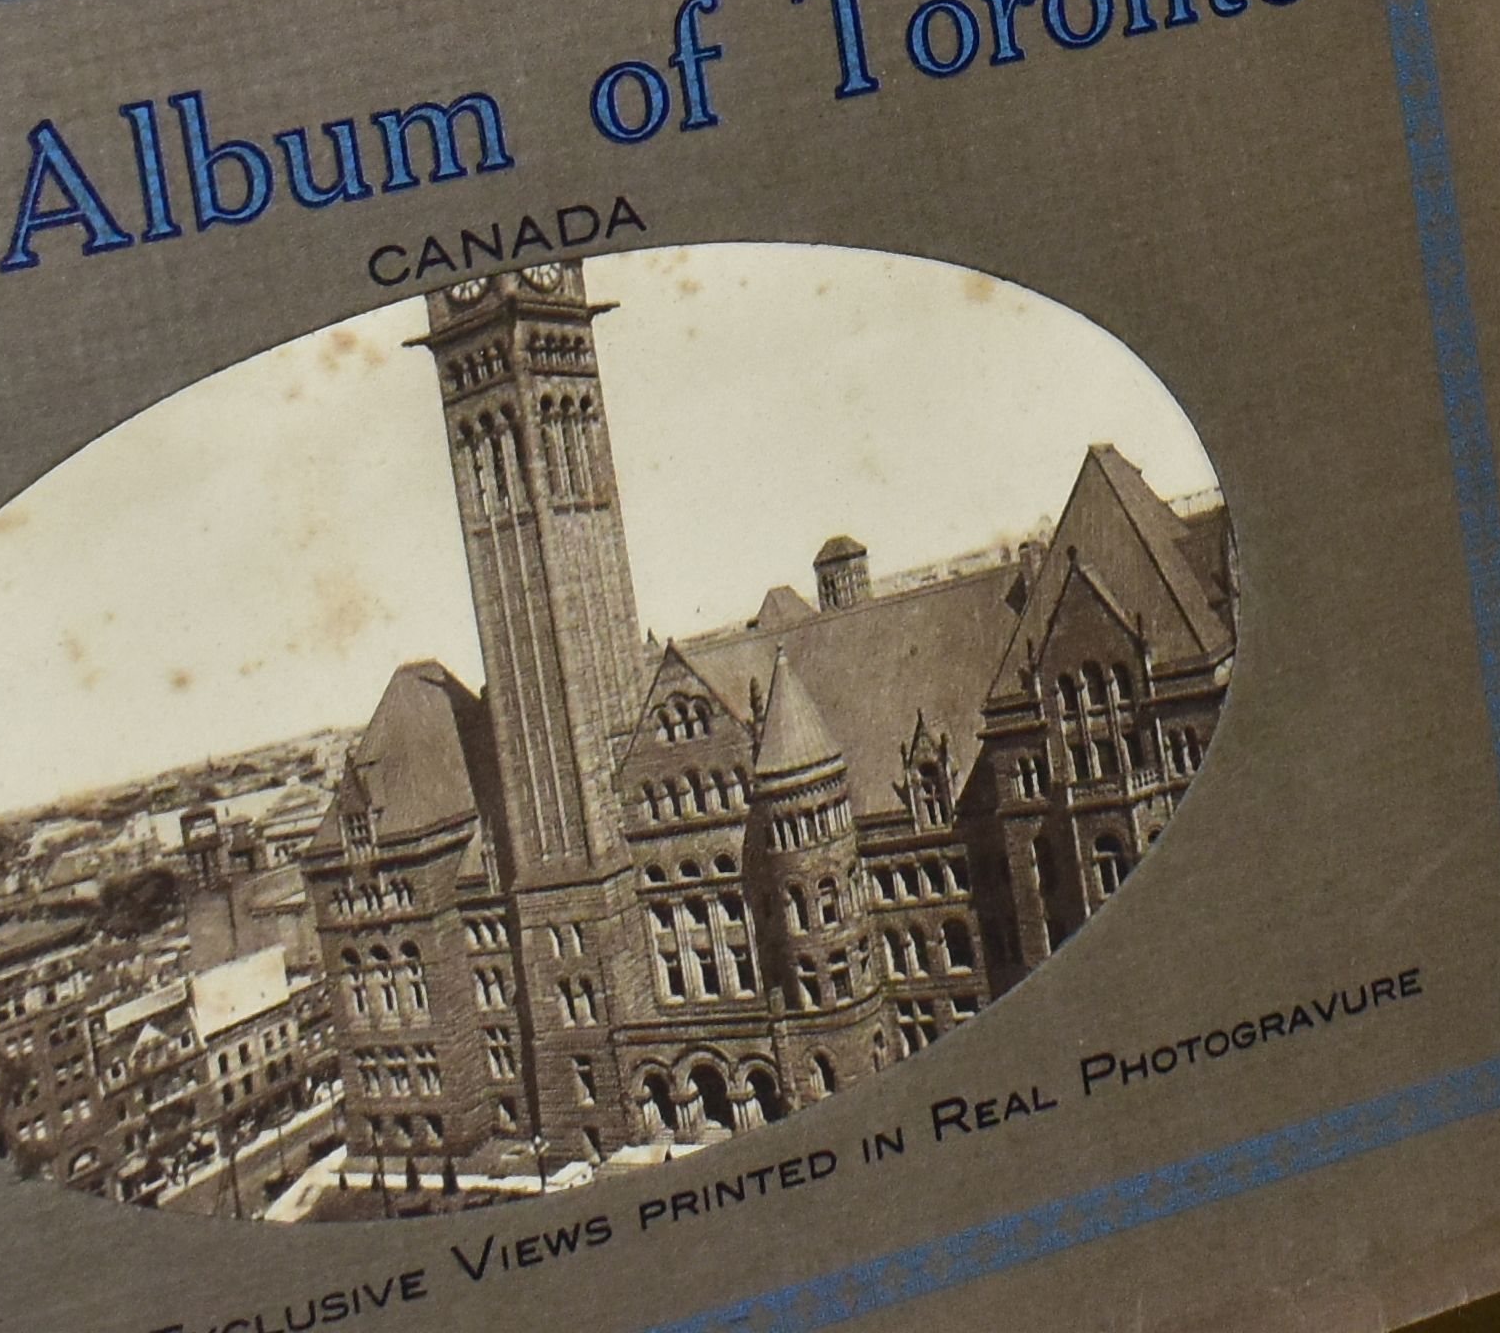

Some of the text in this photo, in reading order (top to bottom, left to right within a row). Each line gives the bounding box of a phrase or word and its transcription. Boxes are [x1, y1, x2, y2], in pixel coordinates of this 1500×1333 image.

[368, 193, 648, 291] CANADA
[638, 1145, 840, 1233] PRINTED
[860, 1121, 905, 1163] IN
